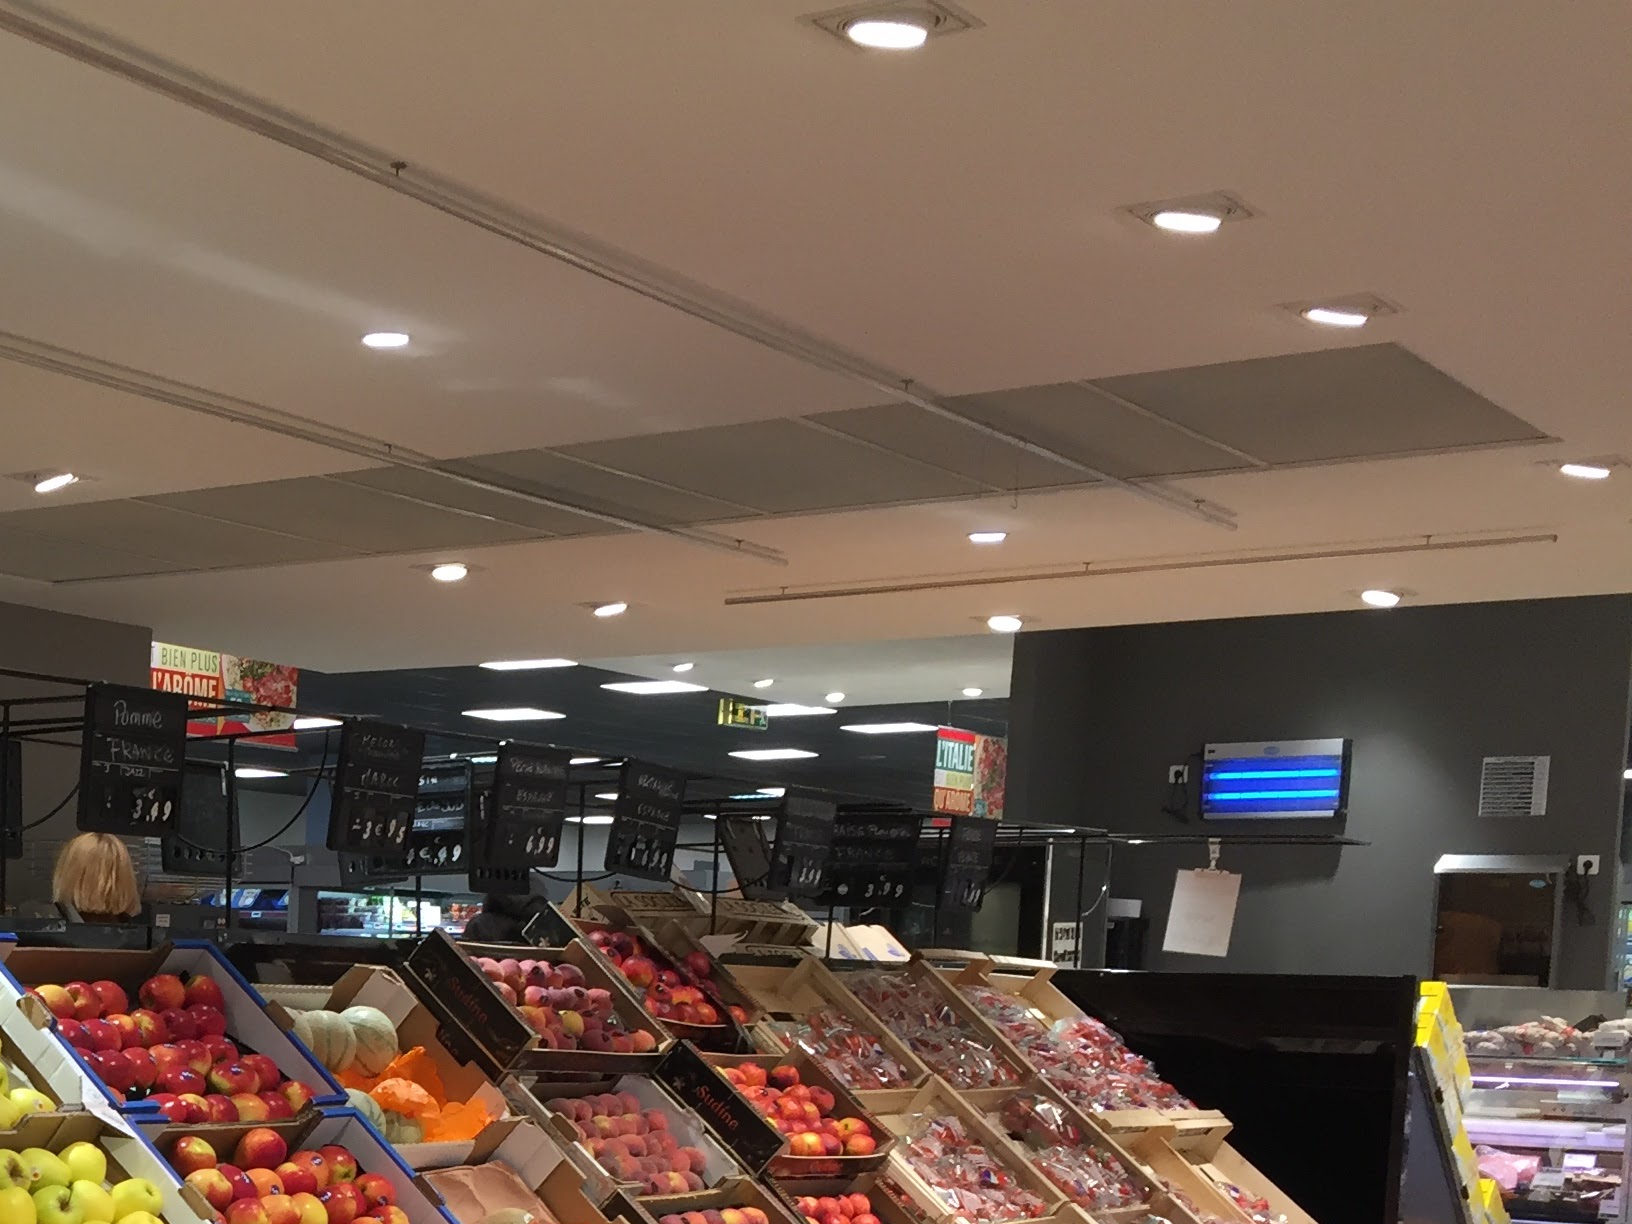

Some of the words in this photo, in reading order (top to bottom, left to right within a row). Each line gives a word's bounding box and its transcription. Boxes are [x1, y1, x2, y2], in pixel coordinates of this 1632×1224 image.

[161, 647, 187, 669] BIEN
[190, 652, 218, 674] PLUS
[113, 699, 164, 729] Pomme
[935, 739, 977, 772] L'ITALIE
